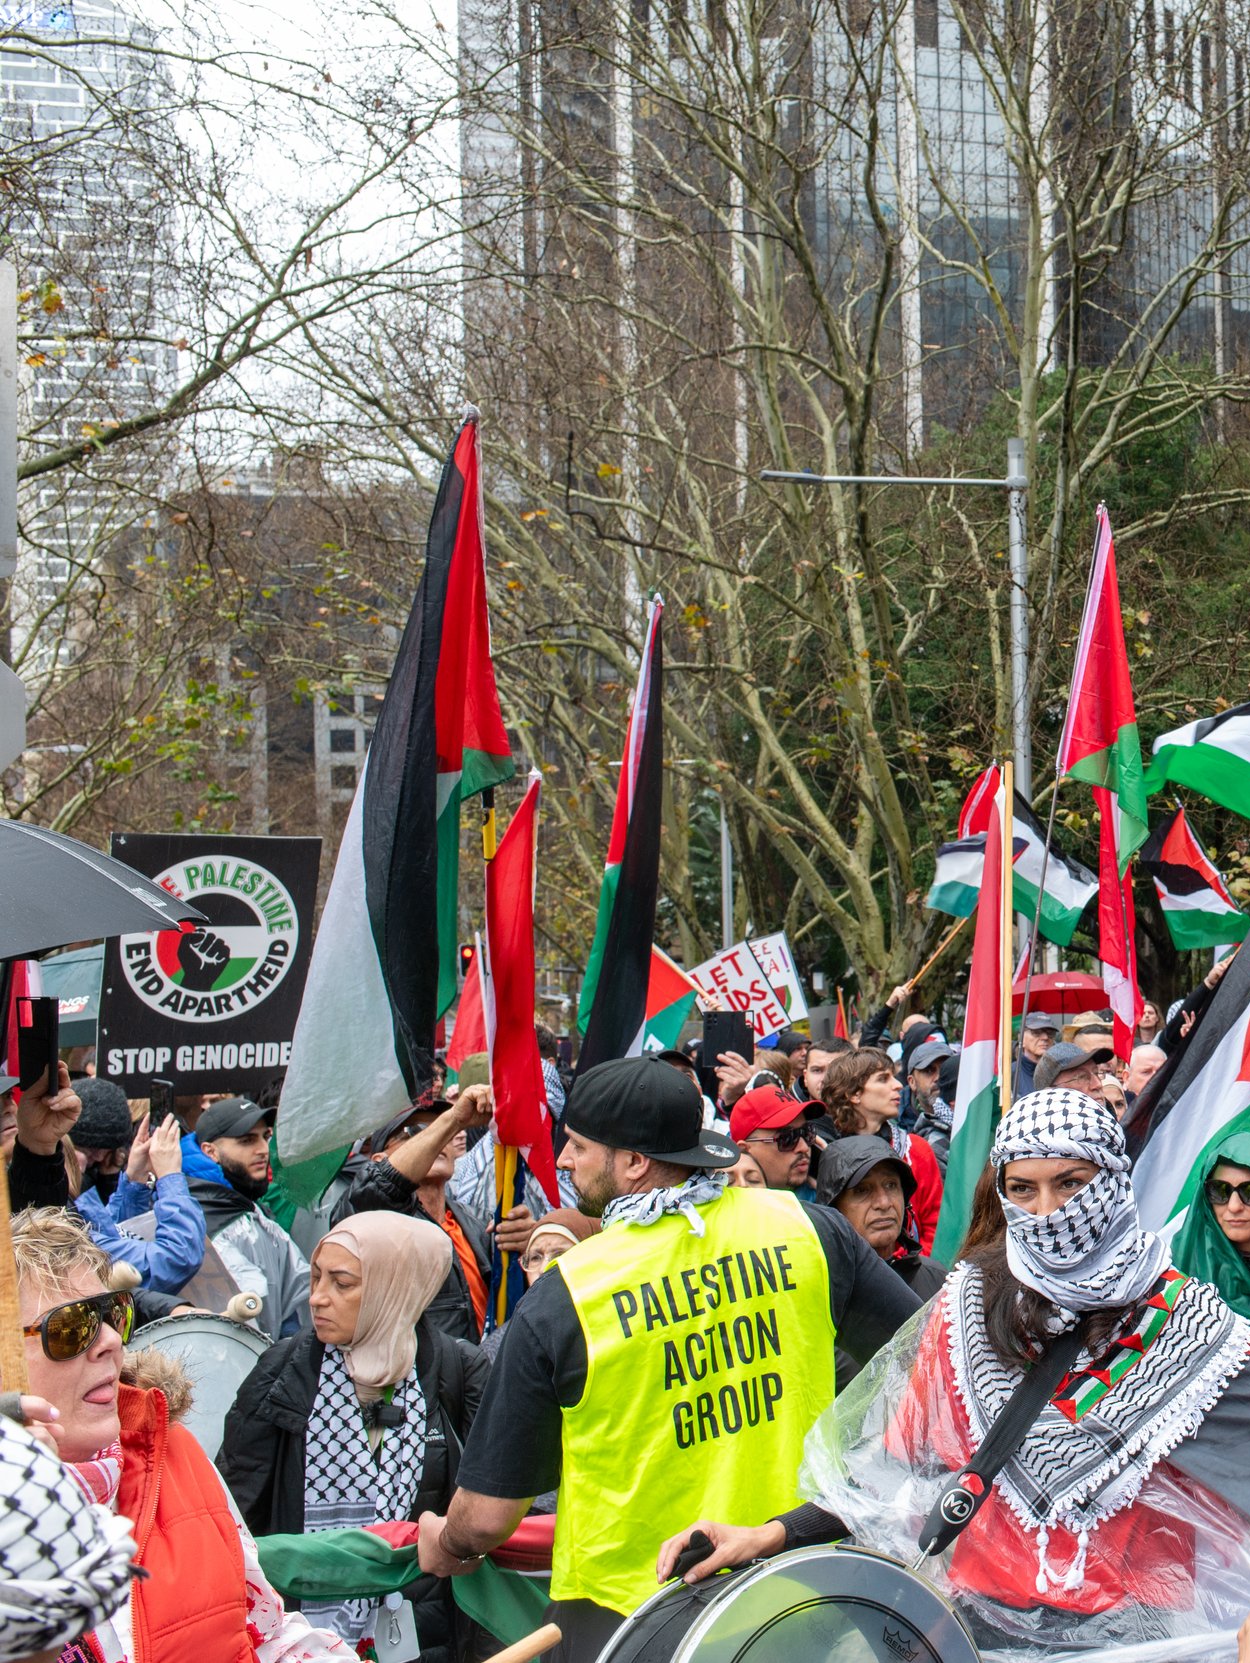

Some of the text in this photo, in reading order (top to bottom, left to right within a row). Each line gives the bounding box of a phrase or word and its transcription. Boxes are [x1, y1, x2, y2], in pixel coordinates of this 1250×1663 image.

[183, 861, 294, 935] PALESTINE
[125, 939, 289, 1017] END APARTHEID
[690, 950, 744, 999] LET
[107, 1041, 292, 1076] STOP GENOCIDE
[611, 1244, 797, 1339] PALESTINE
[663, 1308, 782, 1391] ACTION
[672, 1372, 783, 1450] GROUP
[885, 1635, 912, 1659] REMO
